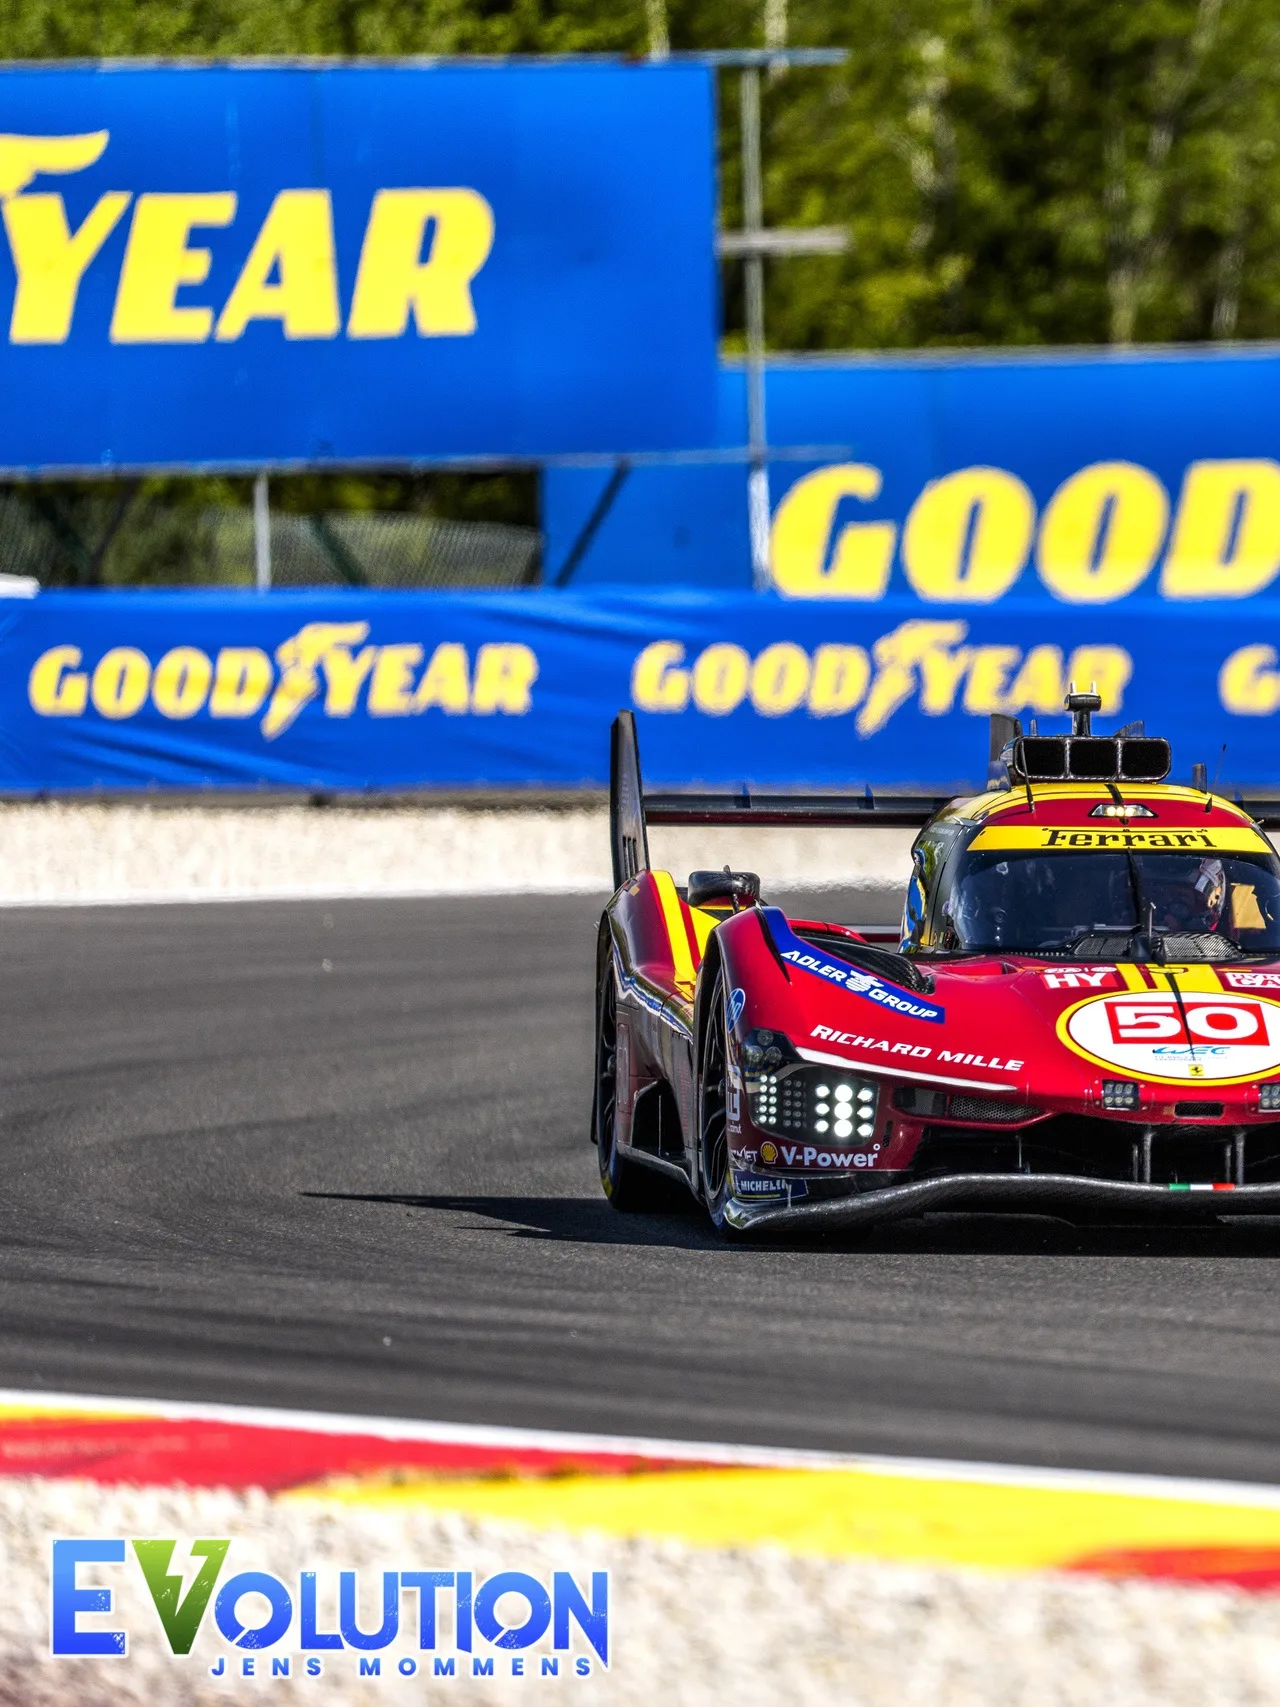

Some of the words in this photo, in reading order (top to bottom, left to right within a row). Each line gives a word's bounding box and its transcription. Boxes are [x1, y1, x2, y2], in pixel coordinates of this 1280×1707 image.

[28, 642, 538, 720] GOODYEAR
[630, 640, 1133, 717] GOODYEAR
[1041, 828, 1218, 848] Ferrari
[780, 950, 848, 982] ADLER
[868, 988, 938, 1018] GROUP
[1114, 1006, 1259, 1040] 50
[810, 1024, 933, 1058] RICHARD
[936, 1050, 1025, 1071] MILLE
[780, 1145, 879, 1167] V-Power
